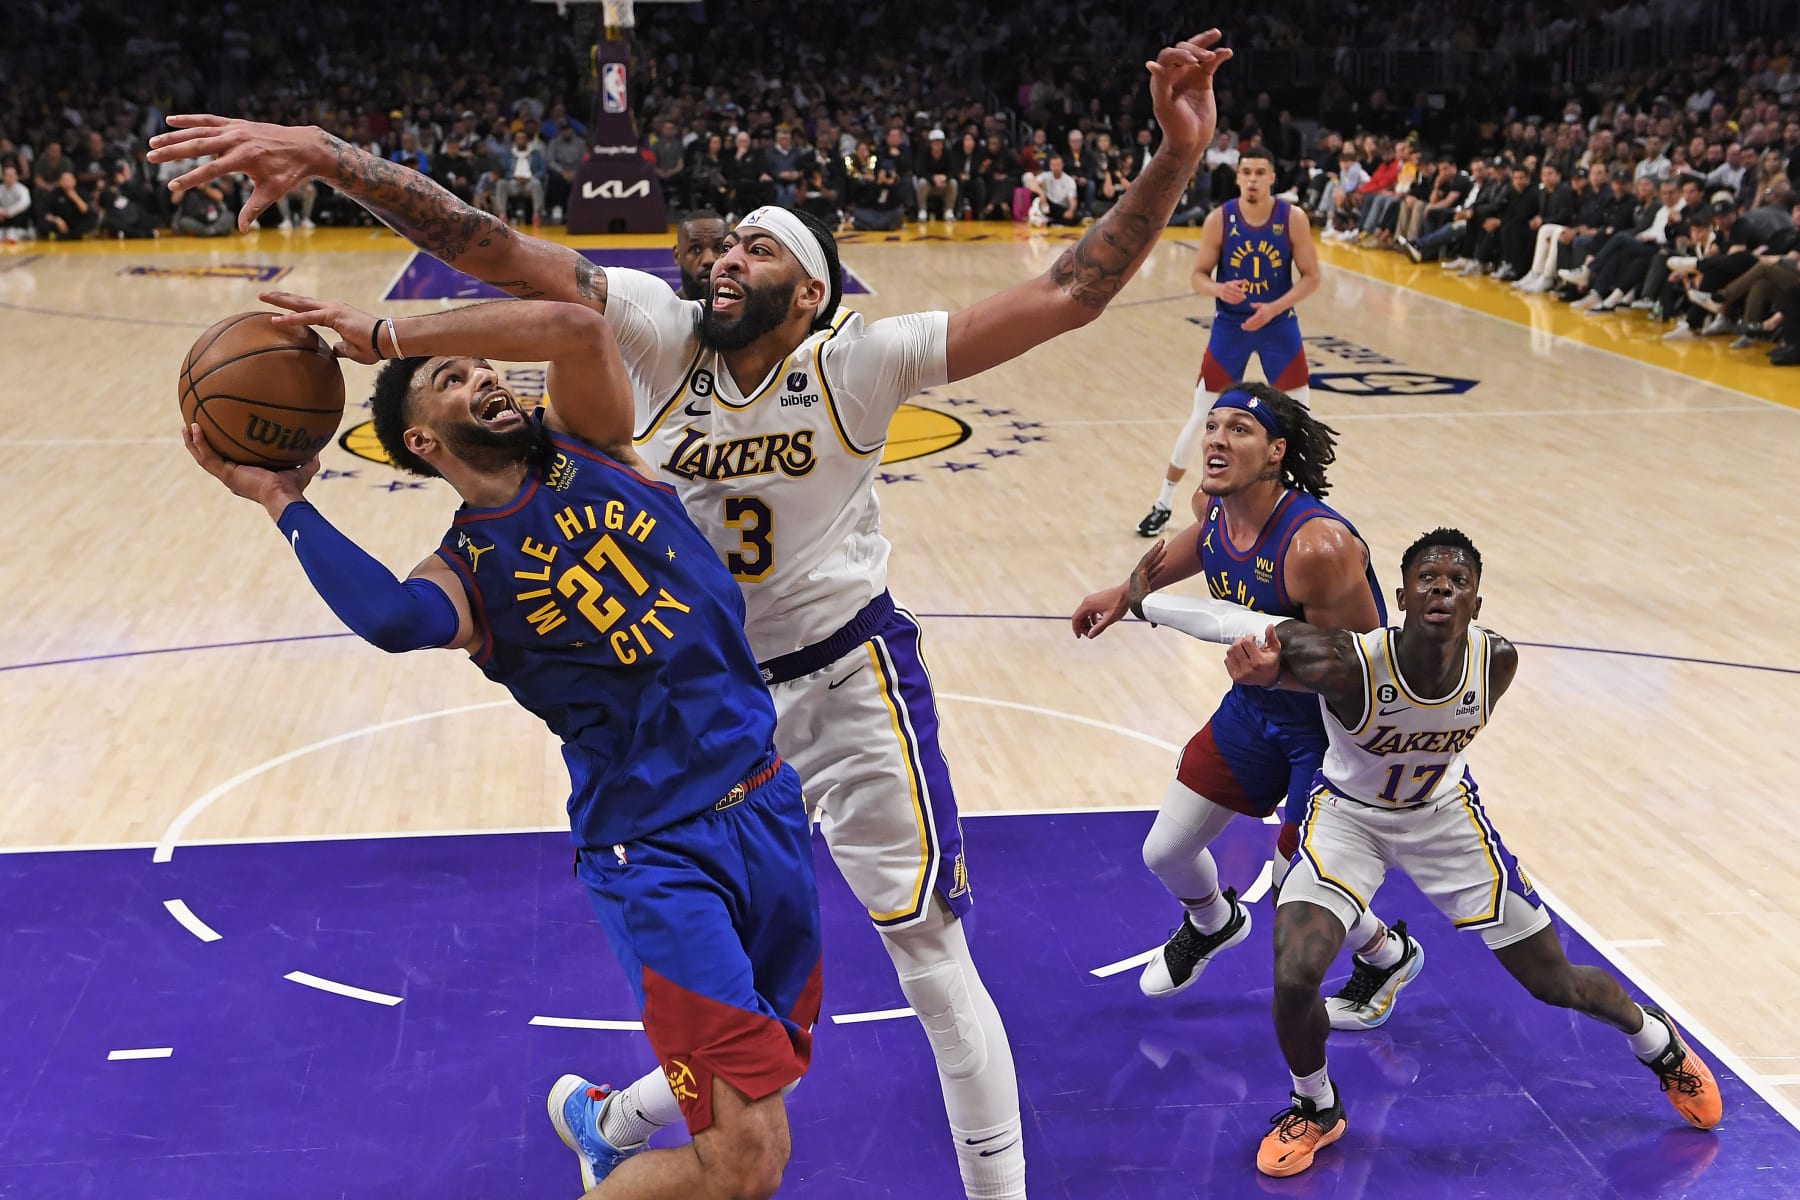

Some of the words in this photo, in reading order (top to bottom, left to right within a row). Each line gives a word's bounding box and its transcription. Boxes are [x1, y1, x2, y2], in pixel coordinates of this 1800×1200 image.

[1229, 239, 1254, 269] MILE
[1252, 255, 1260, 279] 1
[1241, 279, 1269, 296] CITY
[698, 373, 711, 394] 6
[780, 393, 819, 407] bibigo
[660, 426, 818, 482] LAKERS
[546, 453, 568, 487] WU
[555, 459, 575, 492] Western
[563, 467, 579, 490] Union
[1210, 506, 1219, 521] 6
[722, 495, 775, 583] 3
[513, 536, 568, 636] MILE
[553, 500, 657, 543] HIGH
[1256, 555, 1274, 573] WU
[556, 532, 650, 634] 27
[1209, 571, 1232, 599] ILE
[609, 588, 691, 665] CITY
[1381, 686, 1393, 703] 6
[1455, 704, 1480, 716] bibigo
[1354, 724, 1480, 757] LAKERS
[1376, 763, 1449, 805] 17
